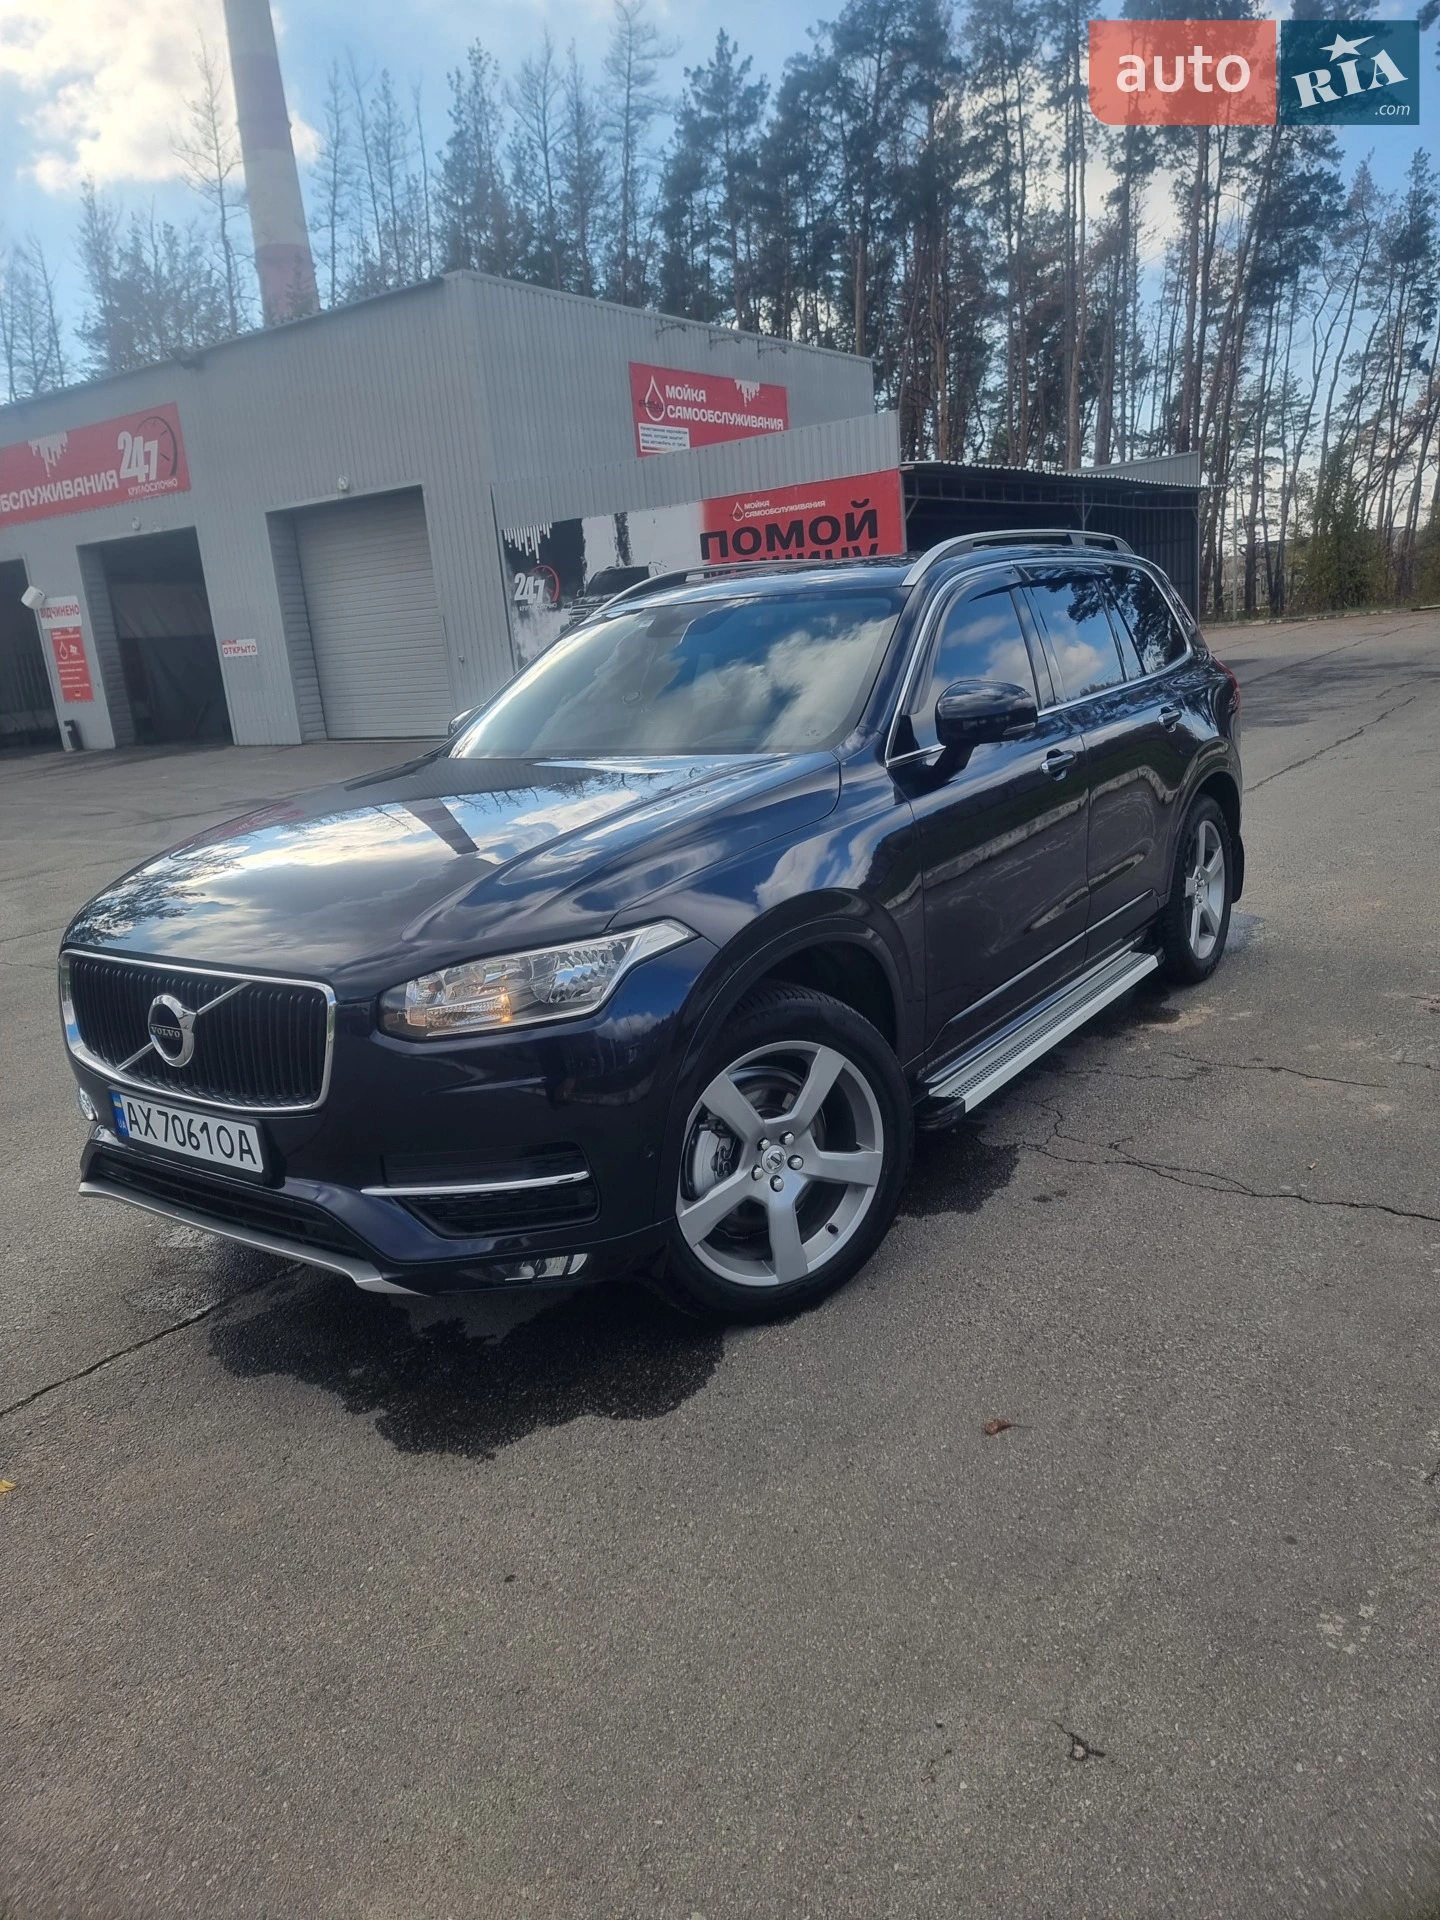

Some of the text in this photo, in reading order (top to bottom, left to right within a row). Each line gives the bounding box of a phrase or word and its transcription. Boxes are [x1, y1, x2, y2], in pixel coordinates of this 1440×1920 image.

[665, 384, 707, 403] МОЙКА
[667, 404, 784, 430] САМООБСЛУЖИВАНИЯ
[0, 470, 119, 512] БСЛУЖИВАНИЯ
[128, 478, 178, 496] КРУГЛОСУТОЧНО
[744, 500, 770, 510] МОЙКА
[744, 500, 826, 518] САМООБСЛУЖИВАНИЯ
[223, 645, 256, 655] ОТКРЫТО
[151, 1026, 180, 1038] VOLVO
